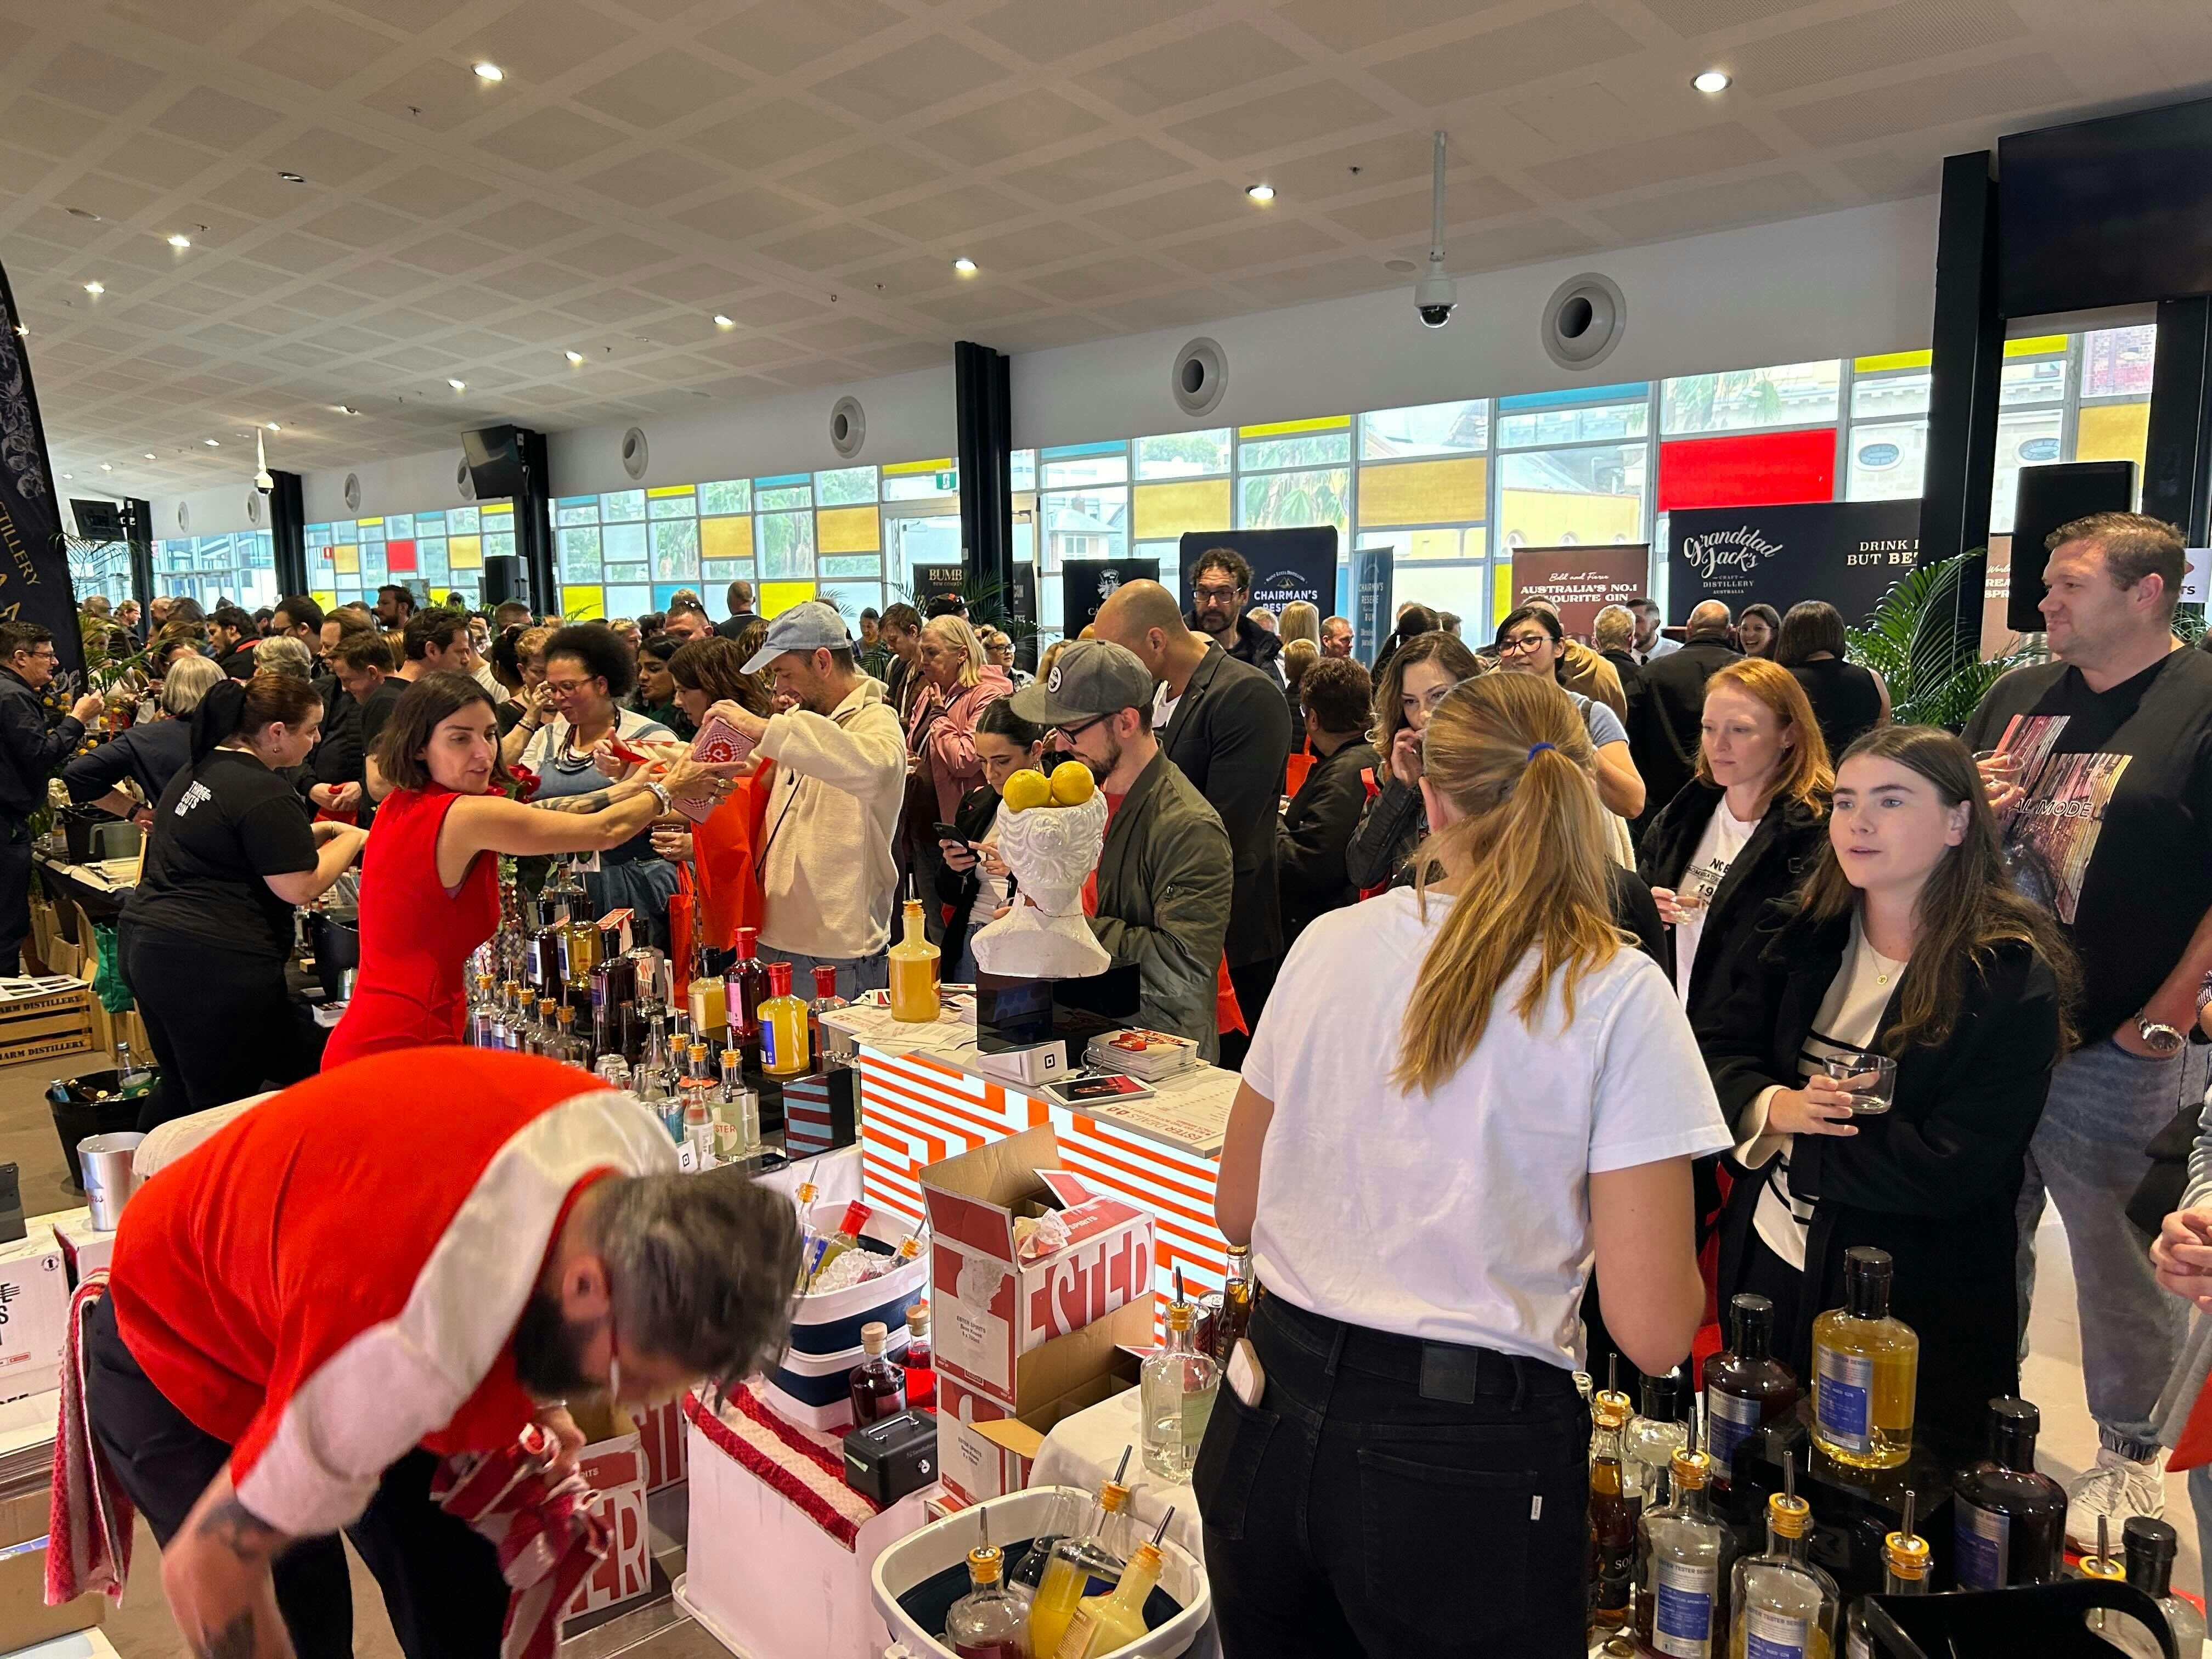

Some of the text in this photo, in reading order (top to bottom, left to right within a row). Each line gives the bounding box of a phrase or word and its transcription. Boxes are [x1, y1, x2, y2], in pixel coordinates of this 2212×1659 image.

[1683, 525, 1784, 567] Granddad
[1859, 539, 1908, 551] DRINK
[1701, 546, 1759, 579] Jack's
[1847, 553, 1881, 566] BUT
[929, 569, 963, 582] BUMB
[1549, 573, 1567, 582] Bold
[1520, 584, 1637, 595] AUSTRALIA'S NO.1
[1703, 580, 1754, 588] DISTILLERY
[1254, 589, 1318, 601] CHAIRMAN'S
[1605, 593, 1628, 602] GIN
[188, 780, 212, 802] THREE
[181, 791, 199, 809] CUTS
[174, 802, 189, 817] GIN
[2036, 799, 2094, 819] MODE
[24, 996, 81, 1011] DISTILLERY
[29, 1041, 84, 1056] DISTILLERY
[1127, 1113, 1165, 1129] DEALS
[1165, 1125, 1203, 1141] ESTER
[1068, 1215, 1098, 1230] SPIRITS
[956, 1315, 986, 1333] ESTER SPIRITS
